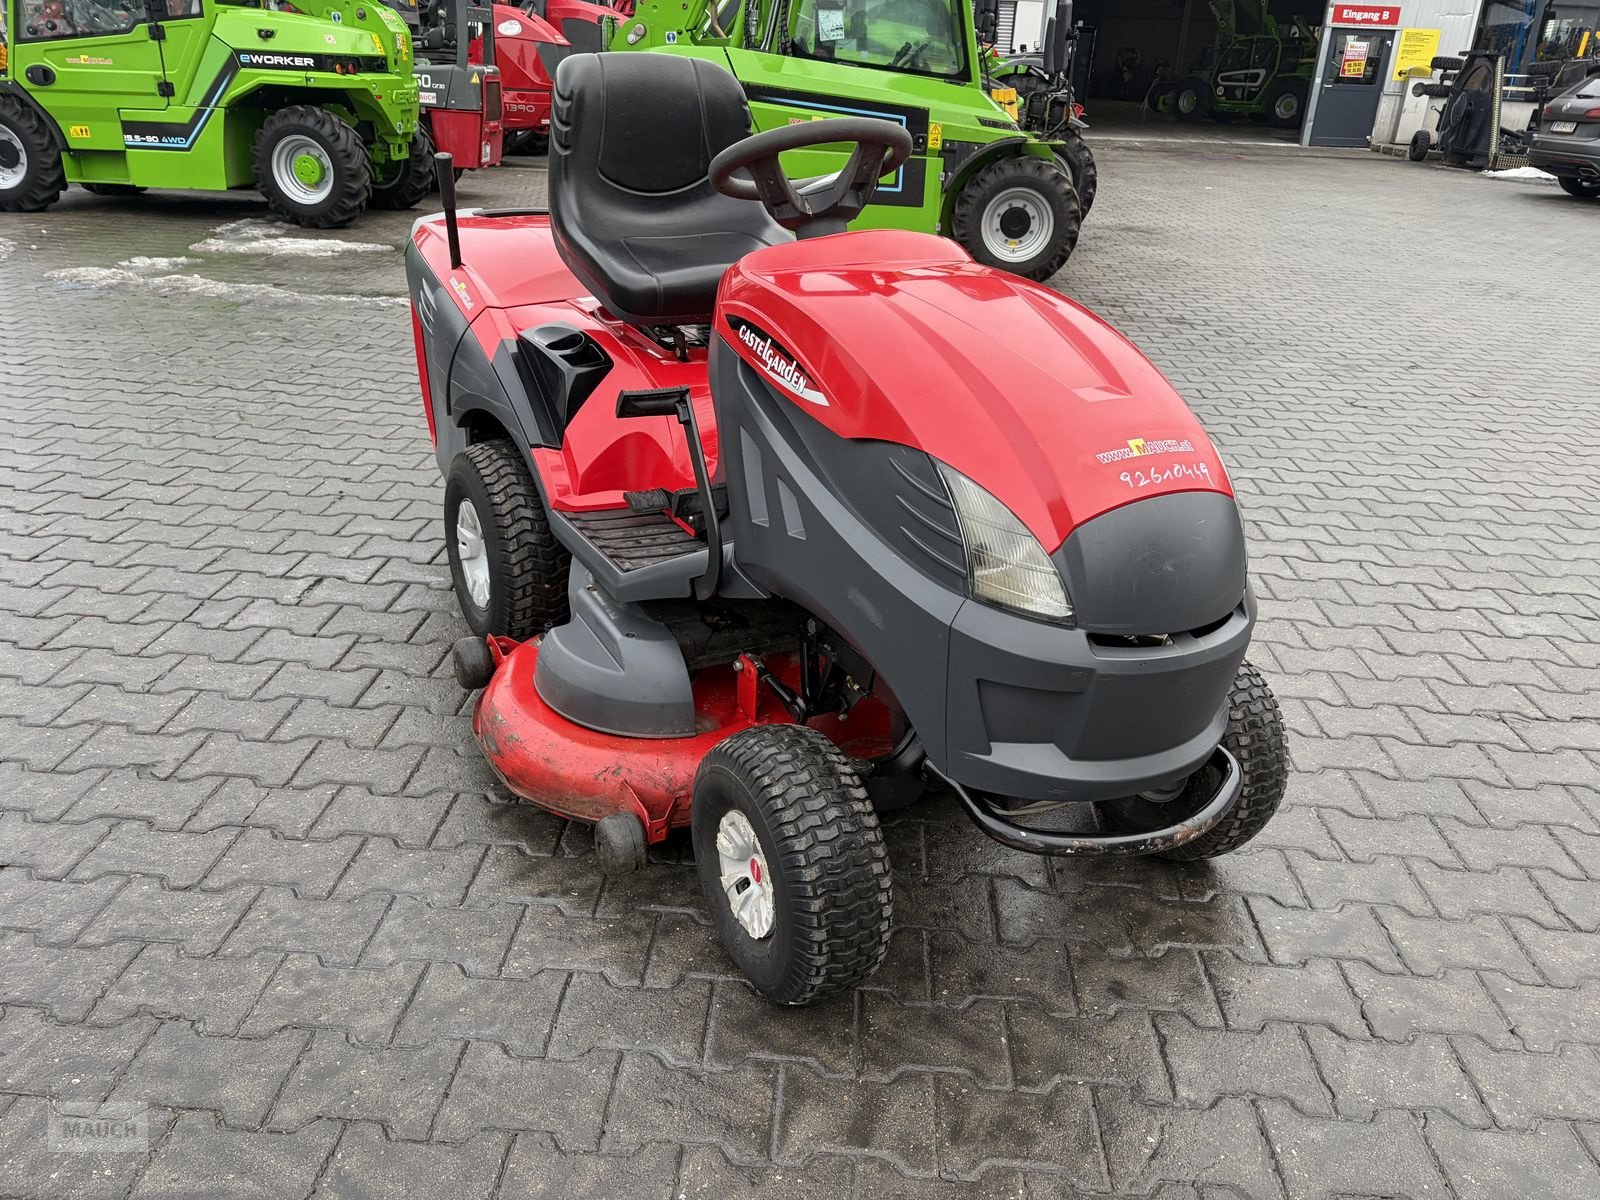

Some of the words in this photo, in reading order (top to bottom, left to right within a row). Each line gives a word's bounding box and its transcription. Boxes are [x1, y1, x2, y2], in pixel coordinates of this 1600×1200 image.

[1342, 9, 1380, 22] Eingang
[1382, 11, 1390, 20] B
[240, 53, 315, 67] eWORKER
[505, 103, 536, 113] 1390
[161, 136, 186, 144] 4WD
